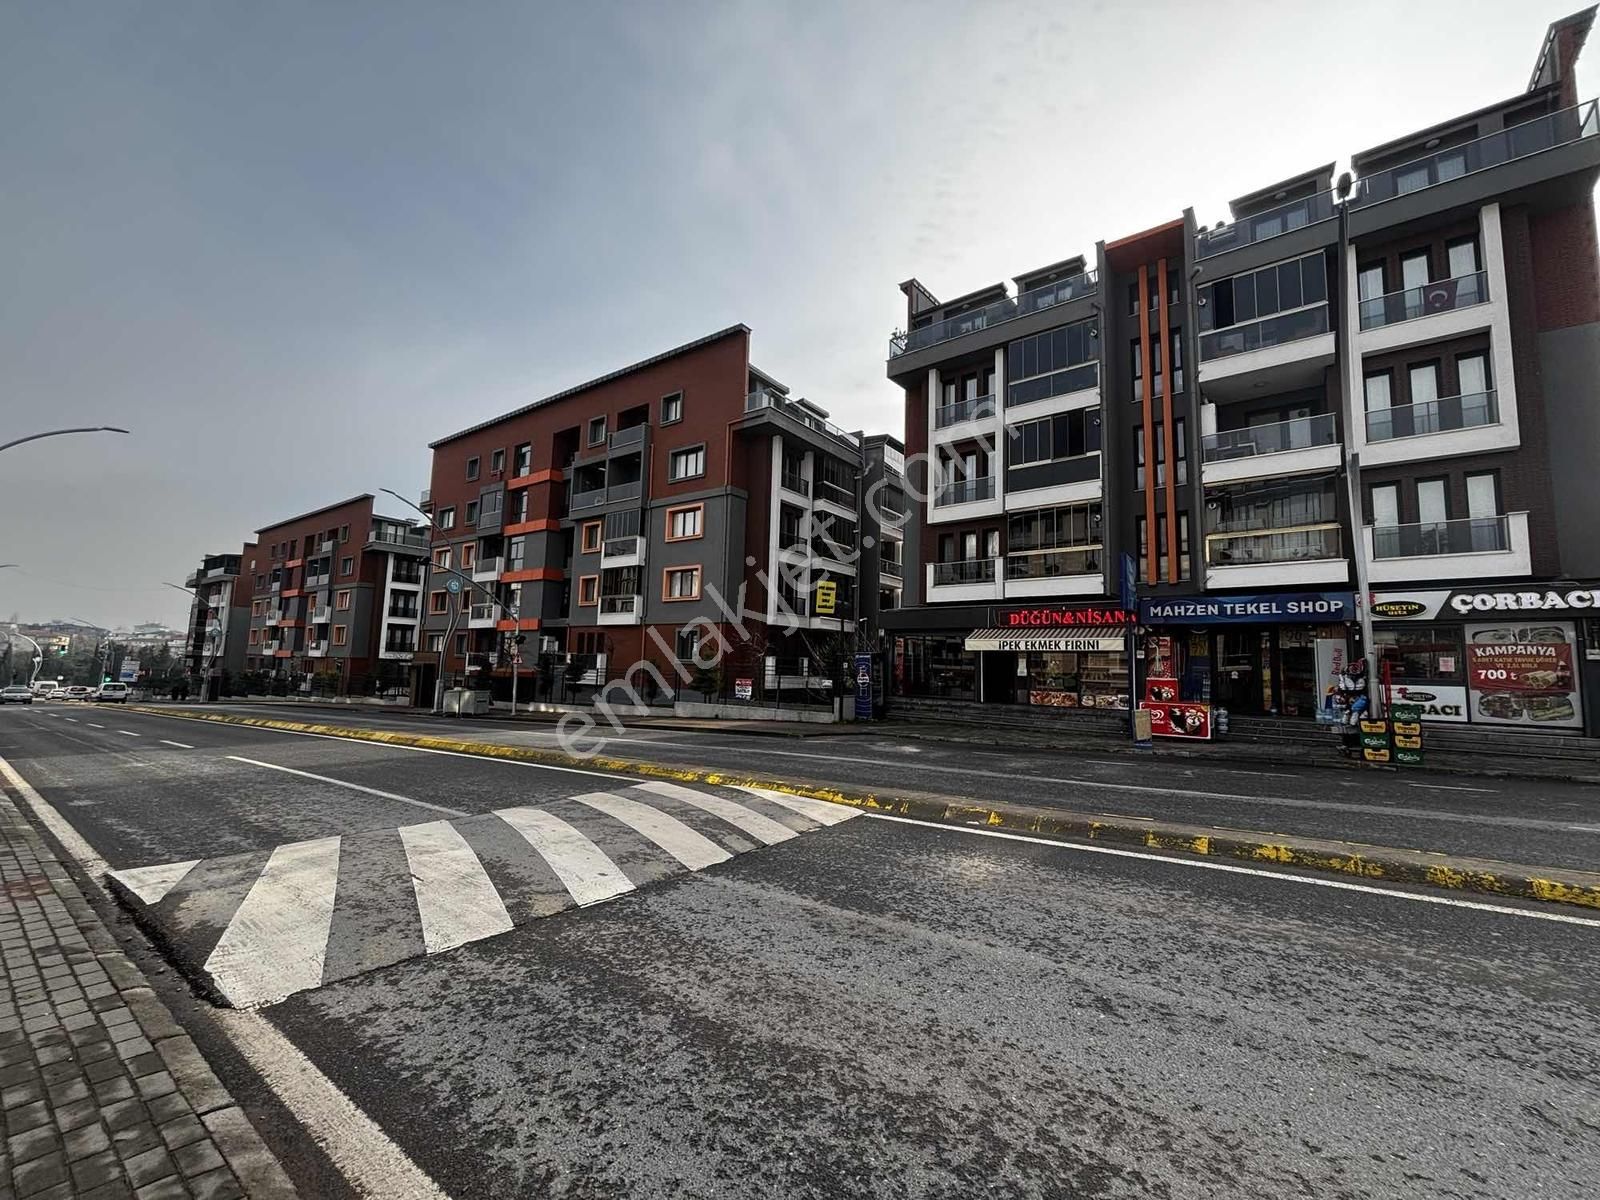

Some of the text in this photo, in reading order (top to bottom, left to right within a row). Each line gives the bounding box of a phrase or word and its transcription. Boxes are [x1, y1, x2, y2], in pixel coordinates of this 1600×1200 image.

[1451, 590, 1600, 614] ÇORBACI
[1150, 600, 1344, 617] MAHZEN TEKEL SHOP
[1025, 639, 1061, 650] EKMEK
[1474, 645, 1556, 657] KAMPANYA
[1477, 669, 1507, 679] 700
